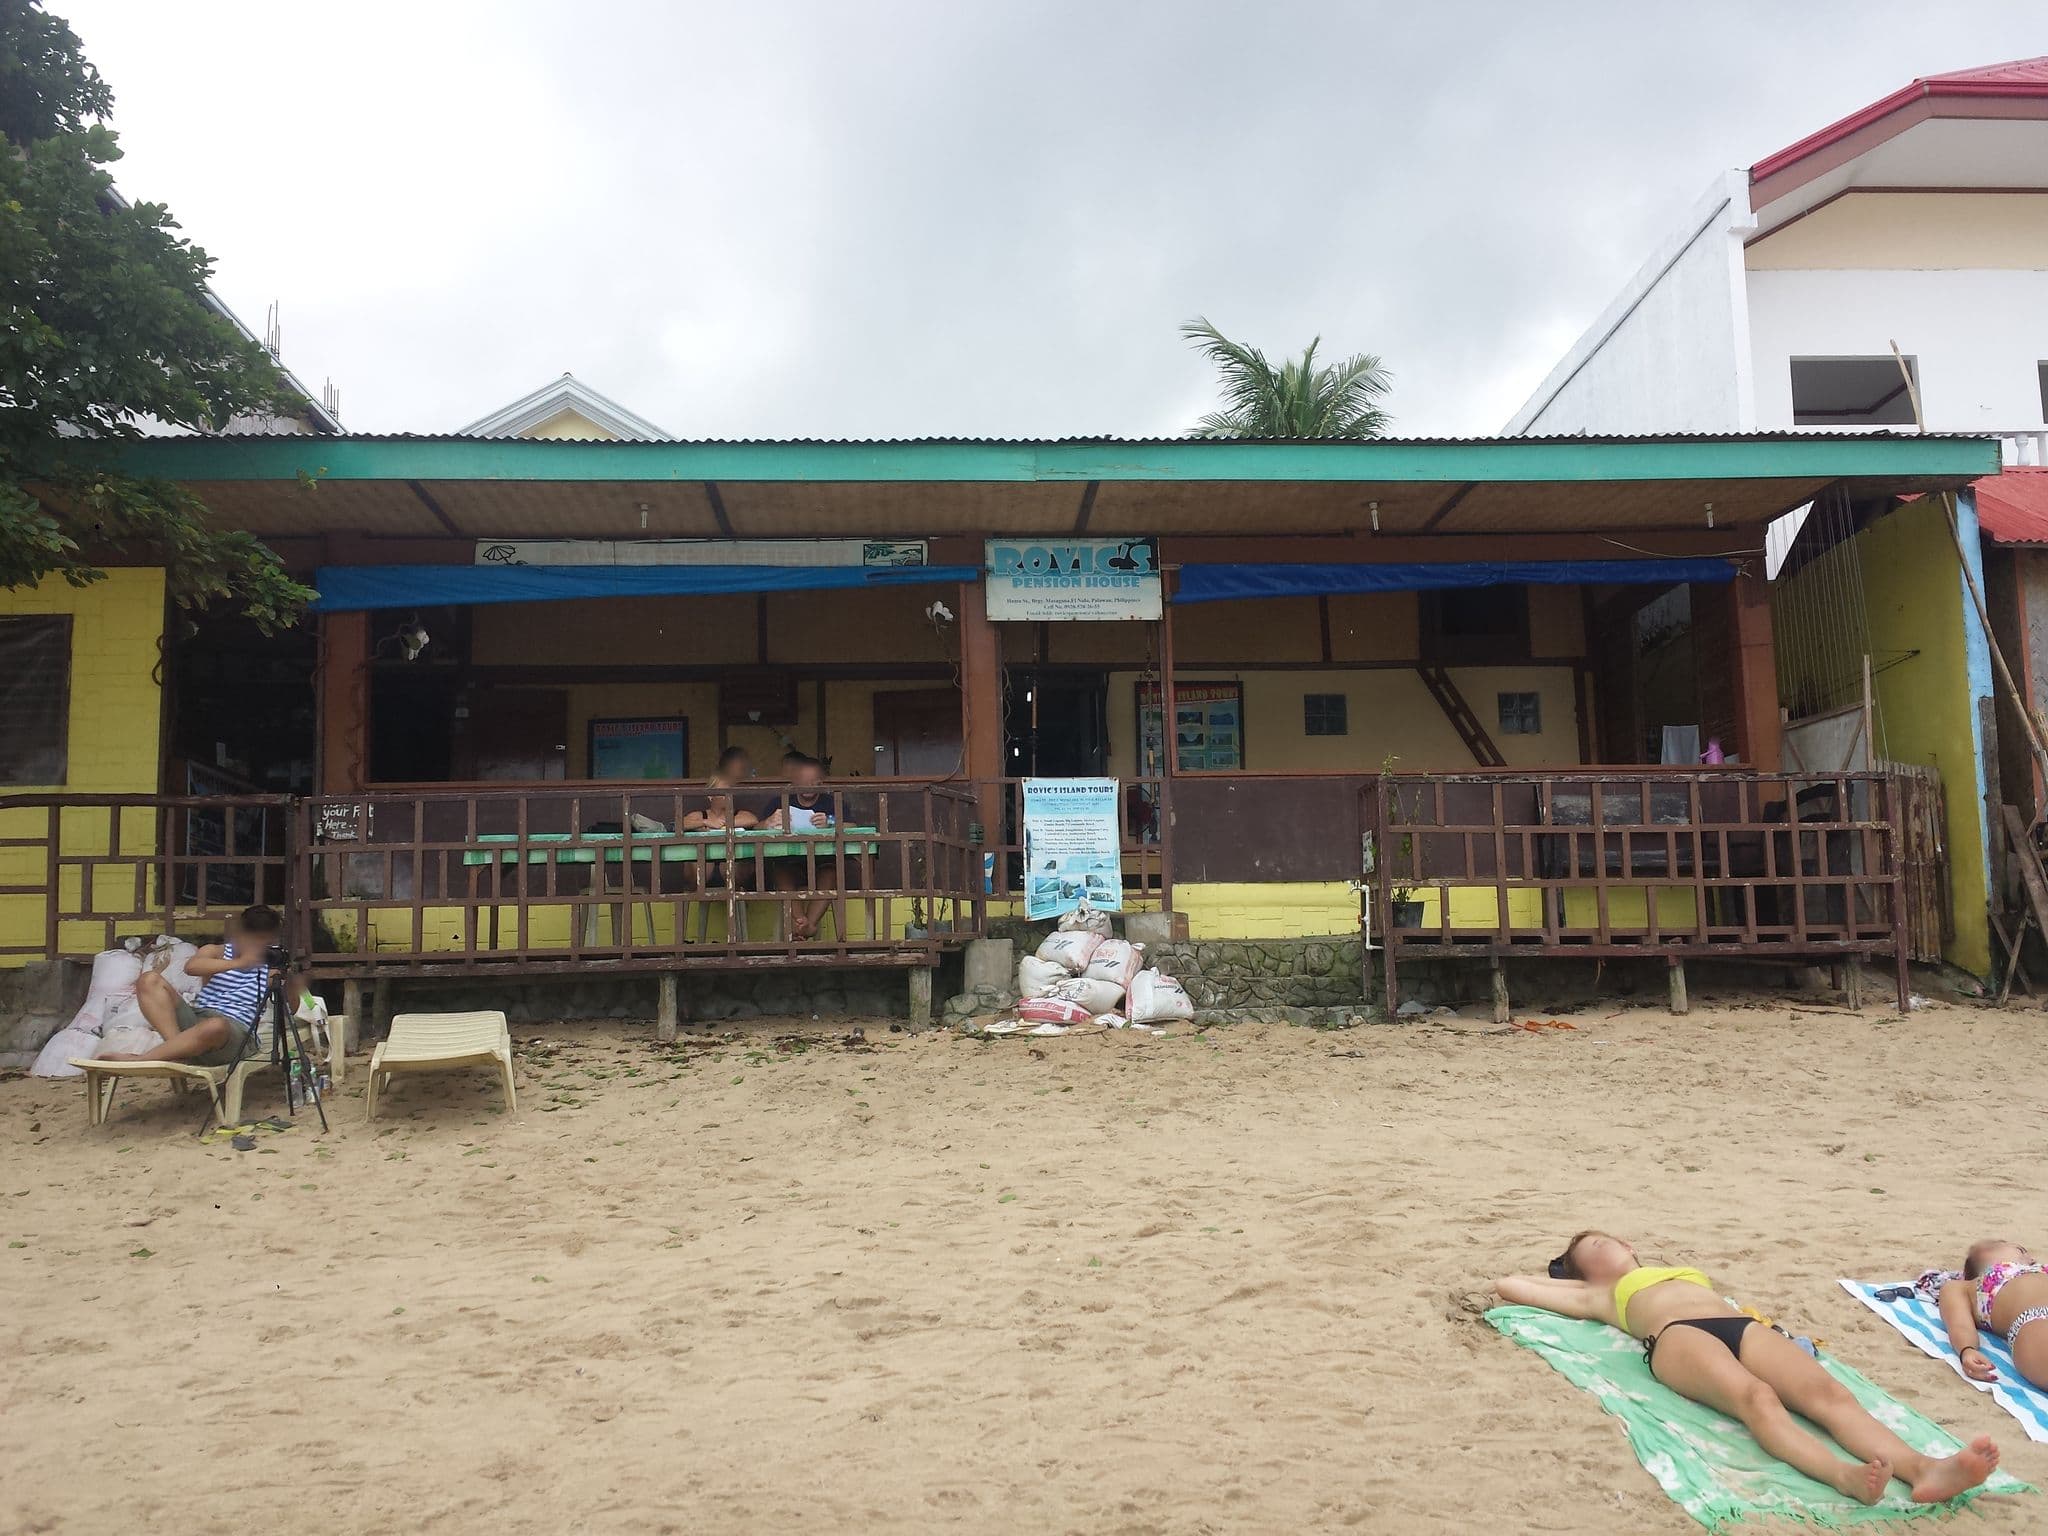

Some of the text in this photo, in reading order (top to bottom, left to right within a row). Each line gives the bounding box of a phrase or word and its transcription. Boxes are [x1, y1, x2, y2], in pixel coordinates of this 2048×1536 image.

[993, 544, 1152, 575] ROVIC'S
[1012, 576, 1141, 588] PENSION HOUSE
[1027, 786, 1114, 794] ROVIC'S ISLAND TOURS
[322, 807, 350, 820] your
